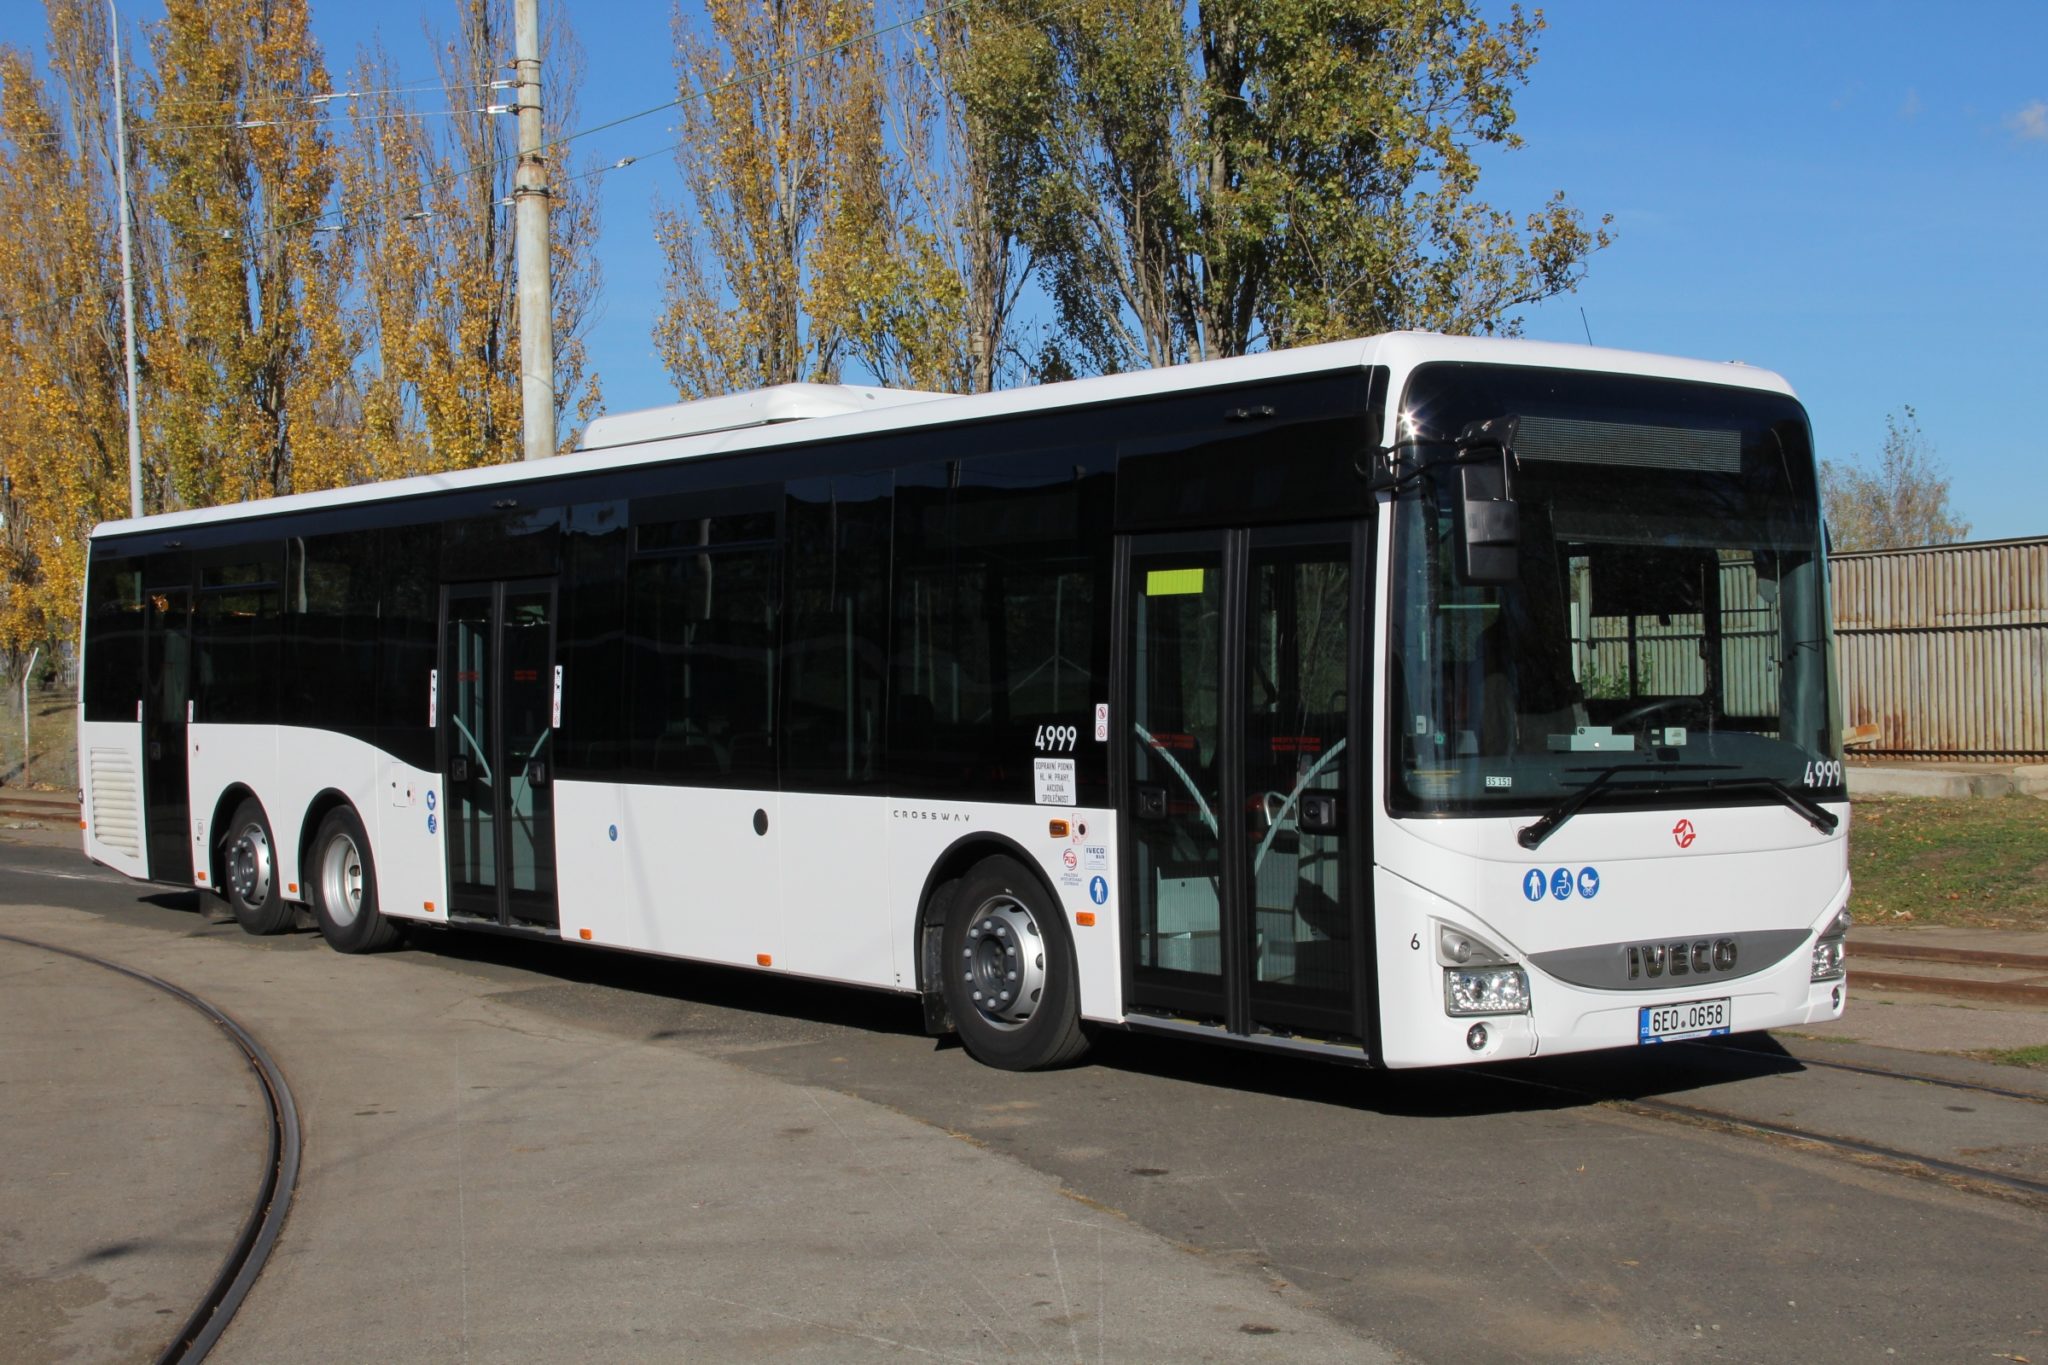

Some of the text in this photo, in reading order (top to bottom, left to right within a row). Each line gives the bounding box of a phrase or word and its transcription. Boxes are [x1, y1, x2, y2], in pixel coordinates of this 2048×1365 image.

[1035, 725, 1077, 751] 4999
[1487, 777, 1511, 786] 35 151
[1803, 760, 1841, 788] 4999
[1410, 932, 1421, 950] 6
[1627, 938, 1738, 981] IVECO
[1689, 1004, 1723, 1028] 0658
